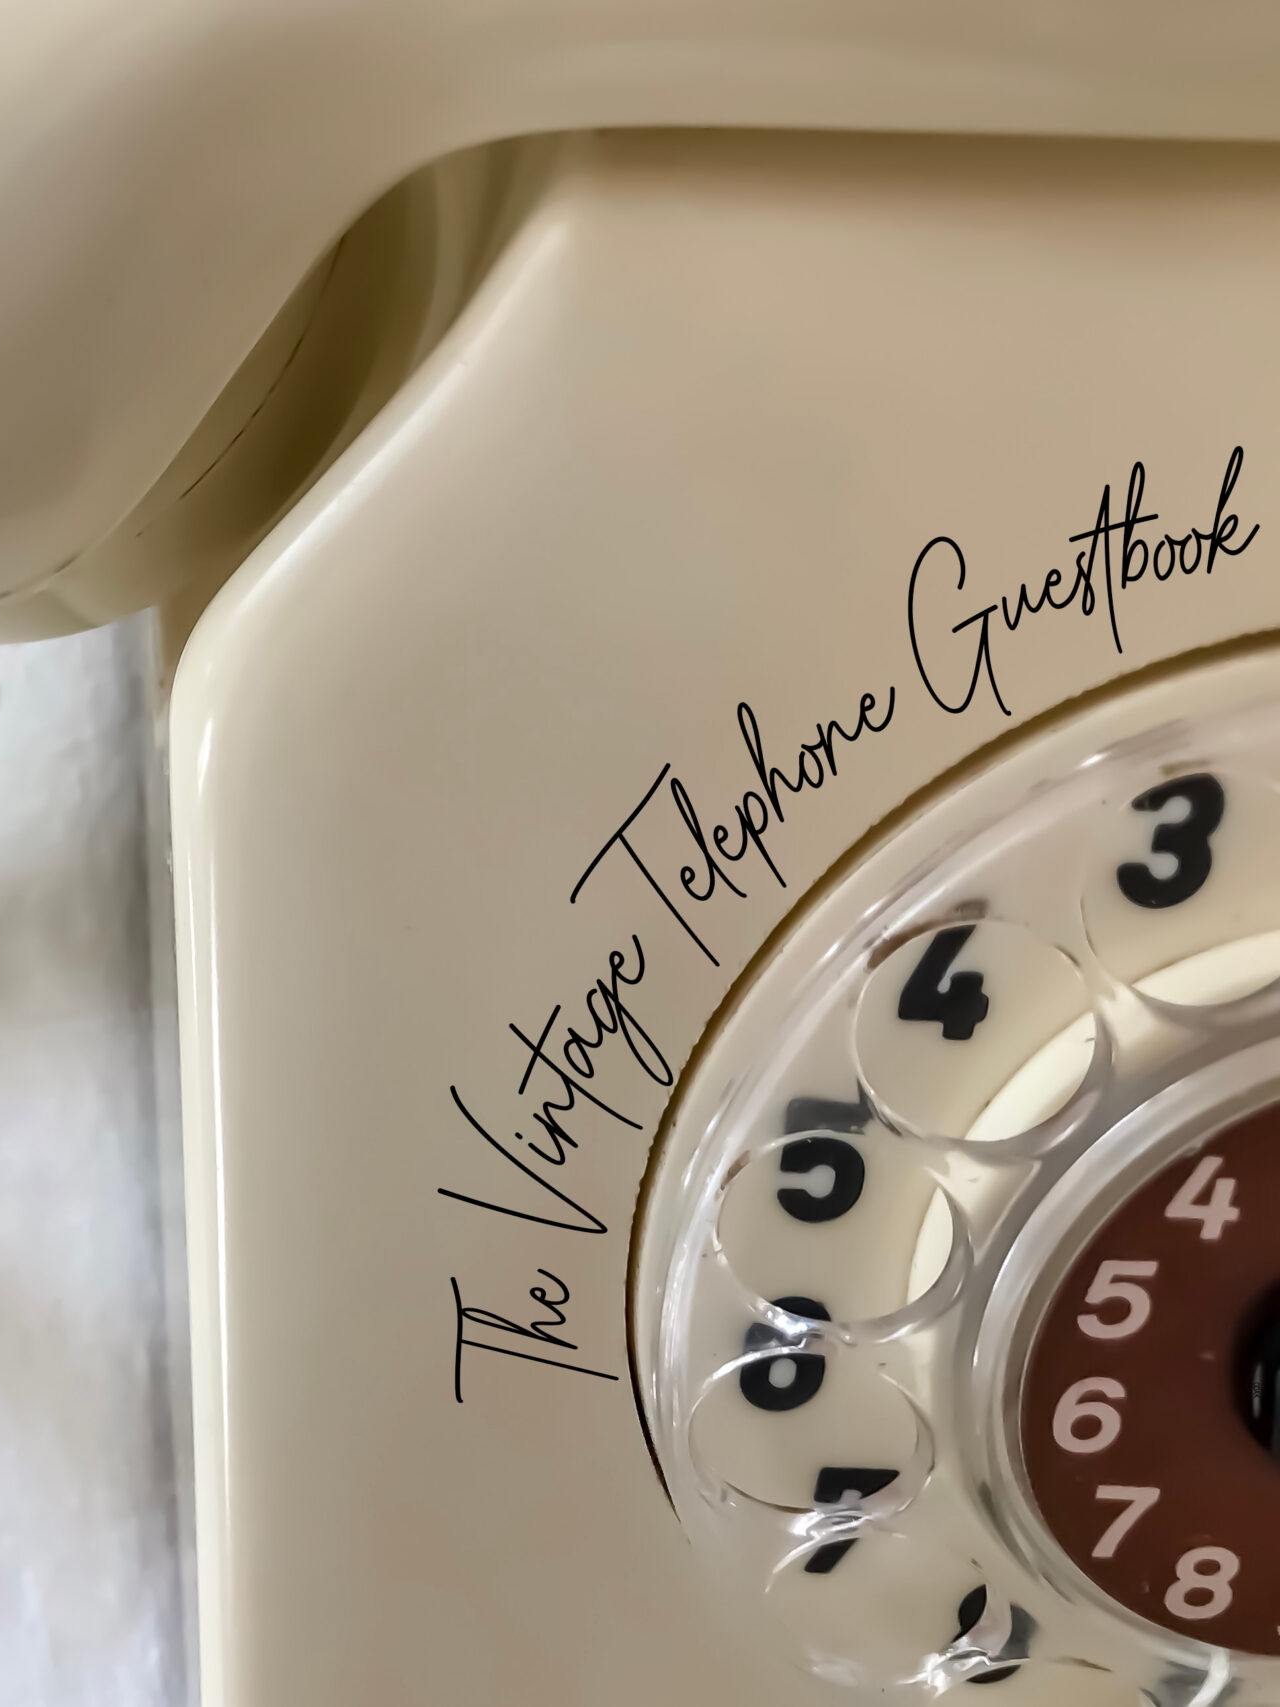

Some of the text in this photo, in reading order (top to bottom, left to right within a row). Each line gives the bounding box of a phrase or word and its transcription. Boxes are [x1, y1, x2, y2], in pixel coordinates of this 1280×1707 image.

[1116, 773, 1225, 910] 3
[897, 906, 990, 1041] 4
[776, 1097, 873, 1224] 5
[1164, 1155, 1240, 1240] 4
[1076, 1260, 1159, 1340] 5
[1052, 1376, 1127, 1454] 6
[1091, 1484, 1161, 1559] 7
[1164, 1546, 1240, 1620] 8
